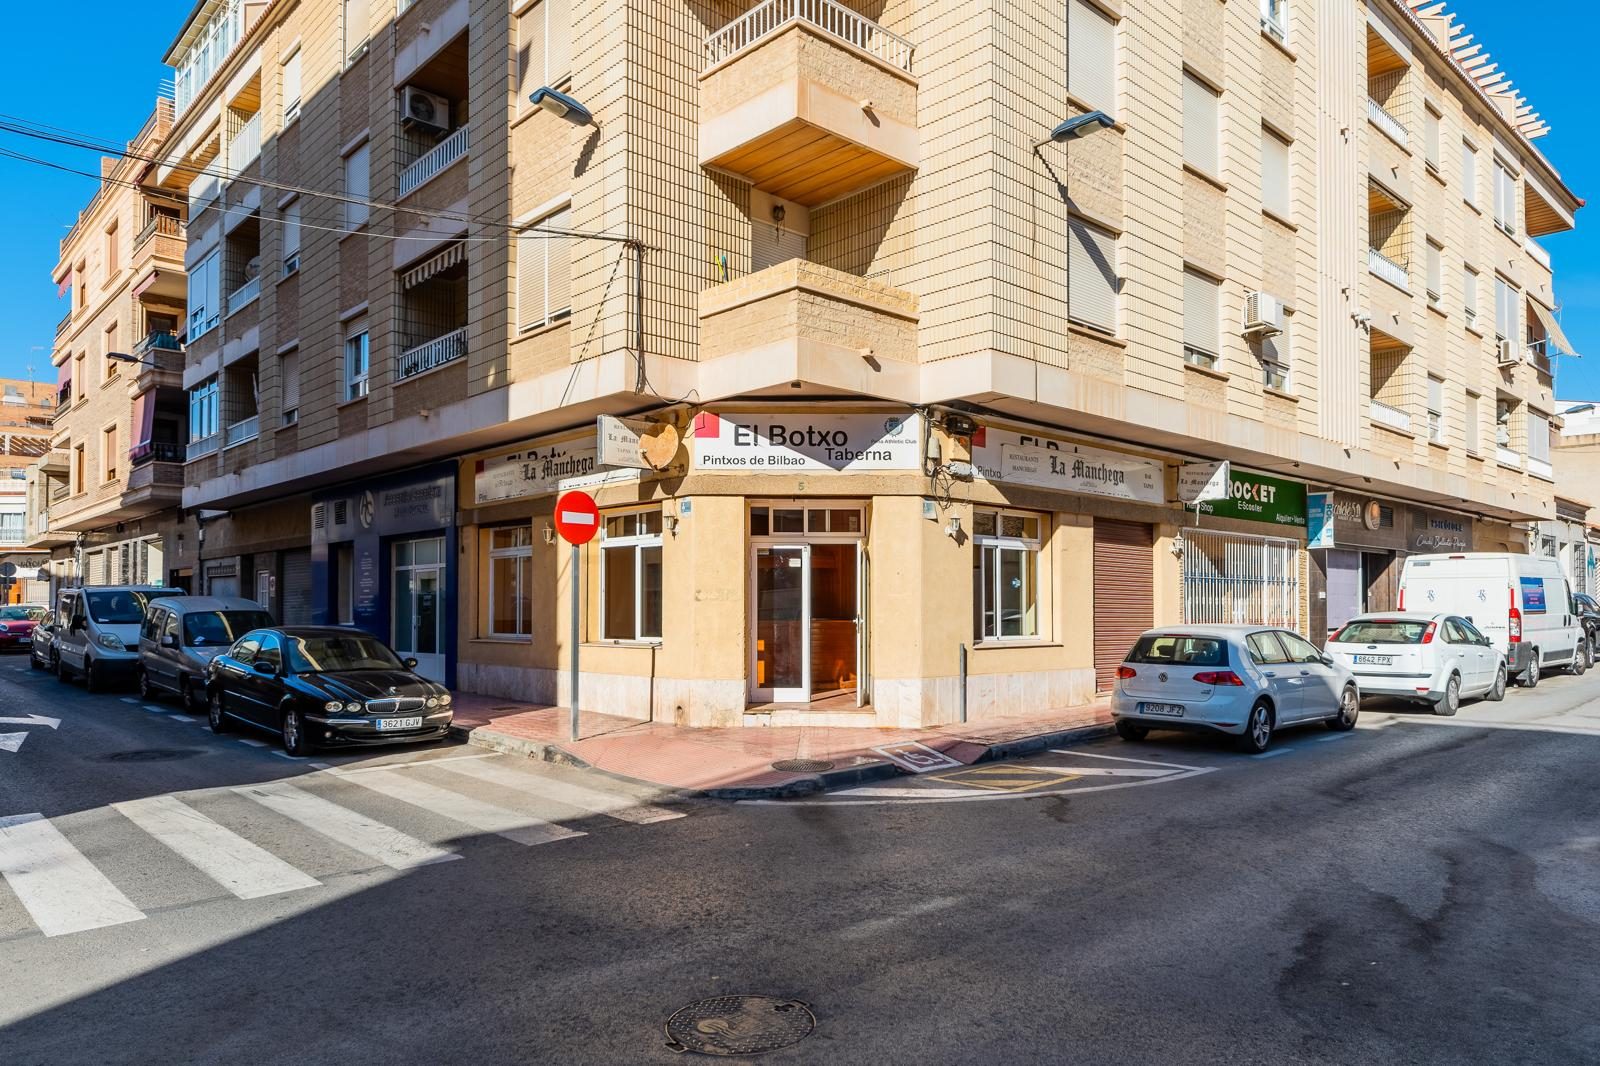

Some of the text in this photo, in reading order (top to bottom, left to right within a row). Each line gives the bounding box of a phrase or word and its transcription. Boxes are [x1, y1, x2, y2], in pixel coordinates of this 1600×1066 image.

[733, 424, 849, 447] El Botxo
[703, 455, 806, 466] Pintxos de Bilbao
[825, 447, 893, 461] Taberna
[522, 463, 537, 481] La
[541, 455, 594, 480] Manchega
[977, 465, 1002, 480] Pintxo
[1049, 455, 1125, 486] La Manchega
[1237, 500, 1263, 513] E-Scooter
[1145, 703, 1182, 714] 9208 JFZ
[383, 718, 420, 728] 3621 GJV
